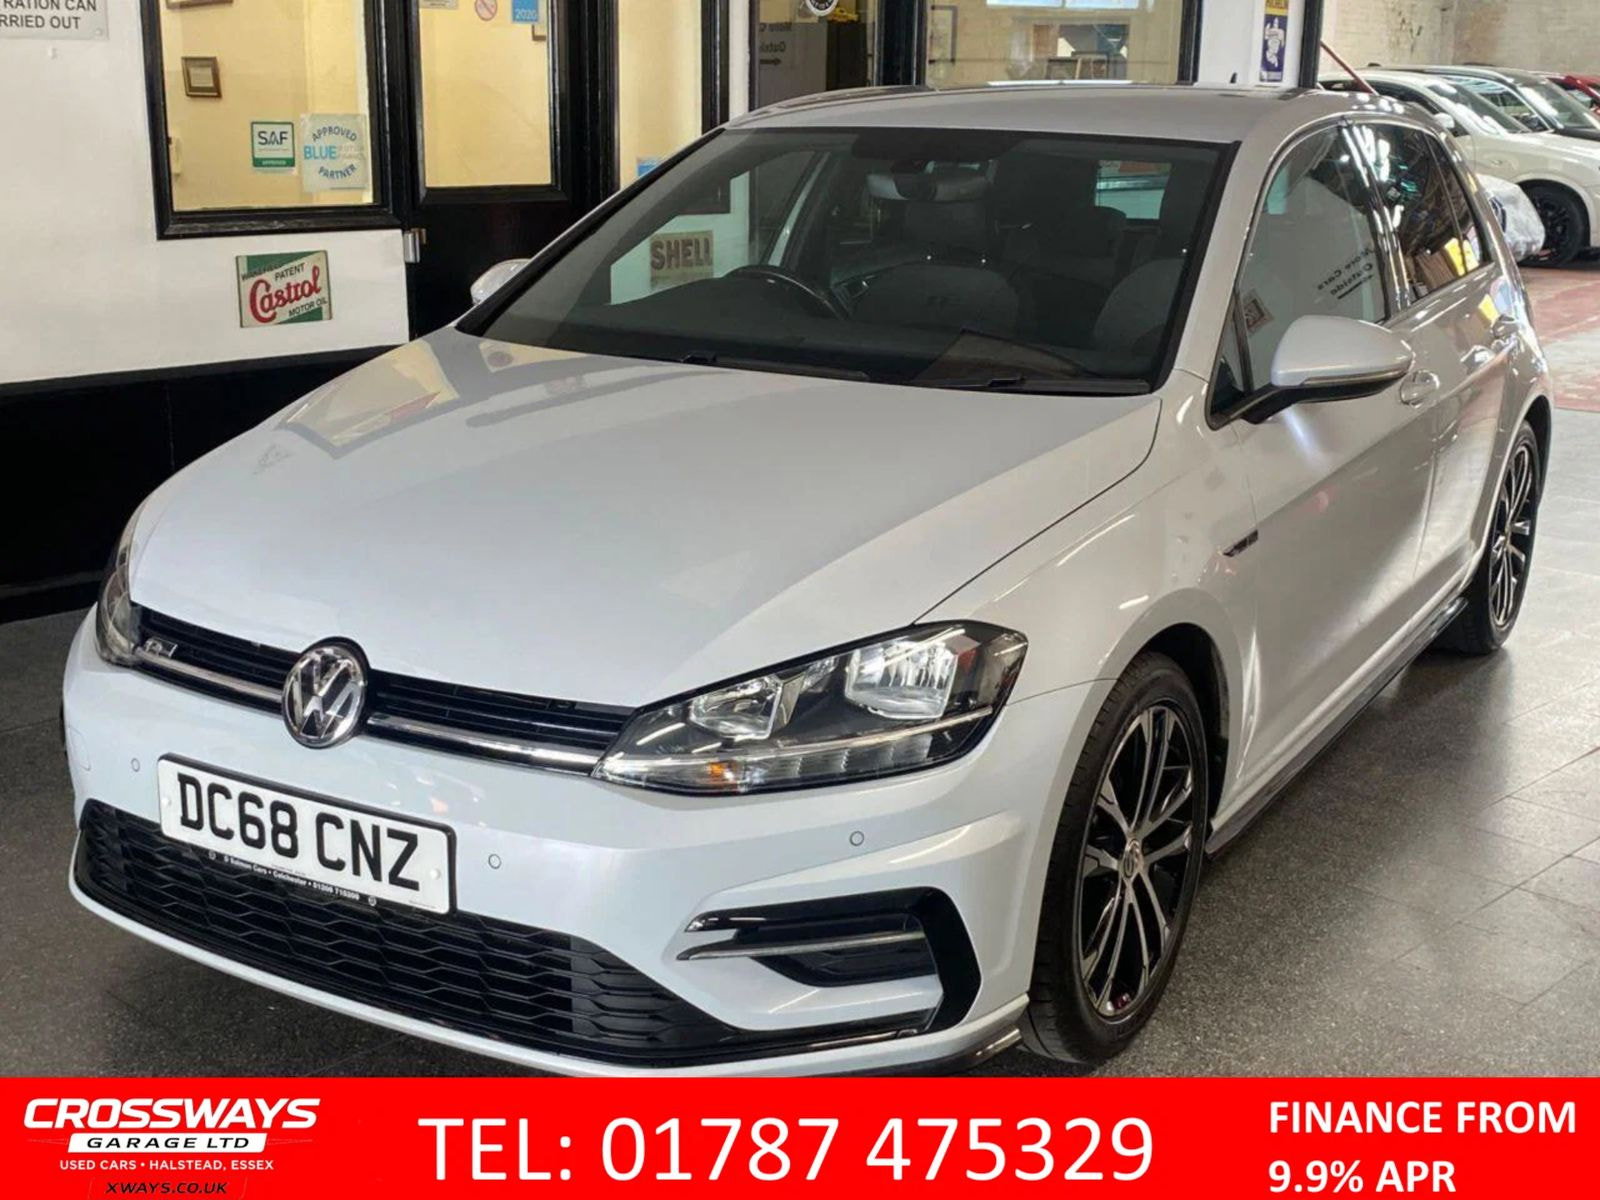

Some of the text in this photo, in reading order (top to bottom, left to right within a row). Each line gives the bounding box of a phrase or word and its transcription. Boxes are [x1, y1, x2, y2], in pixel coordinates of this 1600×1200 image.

[65, 0, 96, 11] CAN
[50, 16, 81, 29] OUT
[257, 130, 288, 145] SAF
[312, 126, 357, 142] APPROVED
[304, 145, 337, 160] BLUE
[319, 164, 357, 179] PARTNER
[650, 238, 713, 270] SHELL
[275, 262, 305, 281] PATENT
[249, 265, 322, 323] Castrol
[288, 301, 315, 317] MOTOR
[177, 772, 420, 891] DC68 CNZ
